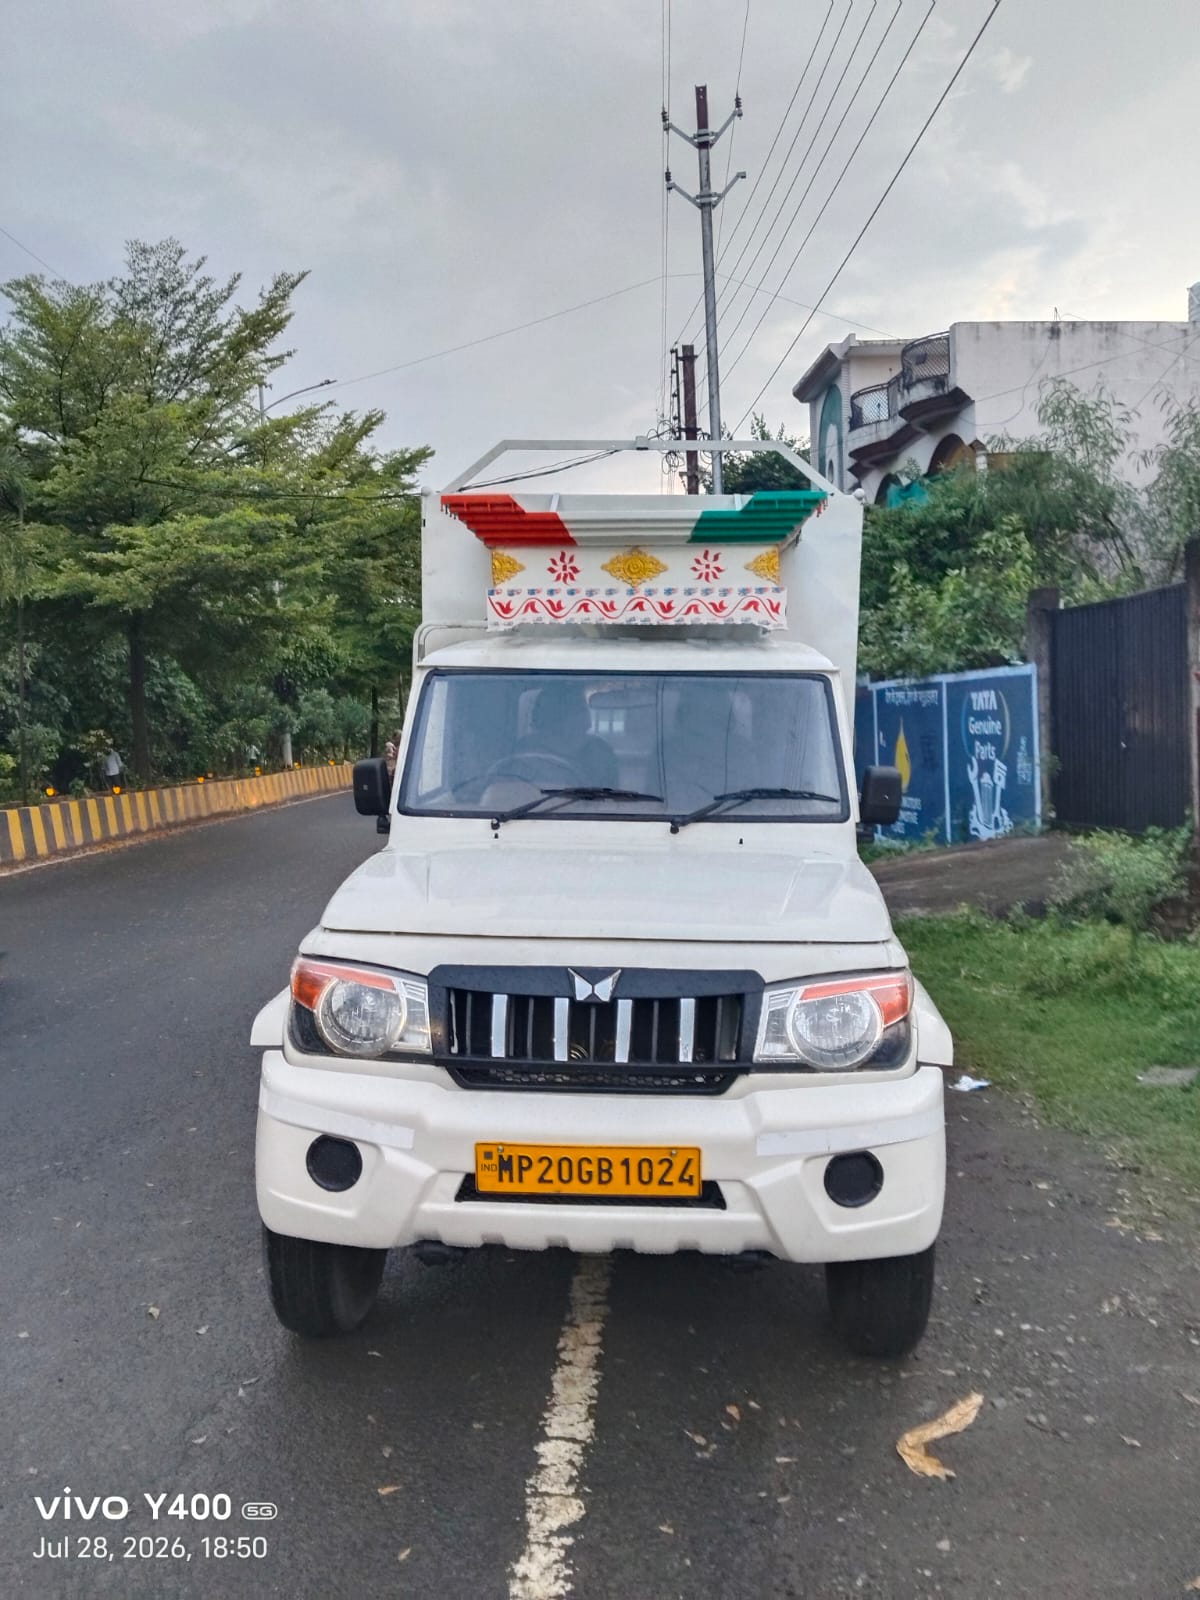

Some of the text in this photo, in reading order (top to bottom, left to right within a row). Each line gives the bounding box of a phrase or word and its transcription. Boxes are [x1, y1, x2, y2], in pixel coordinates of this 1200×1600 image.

[970, 690, 998, 710] TATA
[968, 715, 1002, 735] Genuine
[974, 741, 997, 760] Parts
[480, 1163, 497, 1172] IND
[498, 1154, 694, 1186] MP20GB1024
